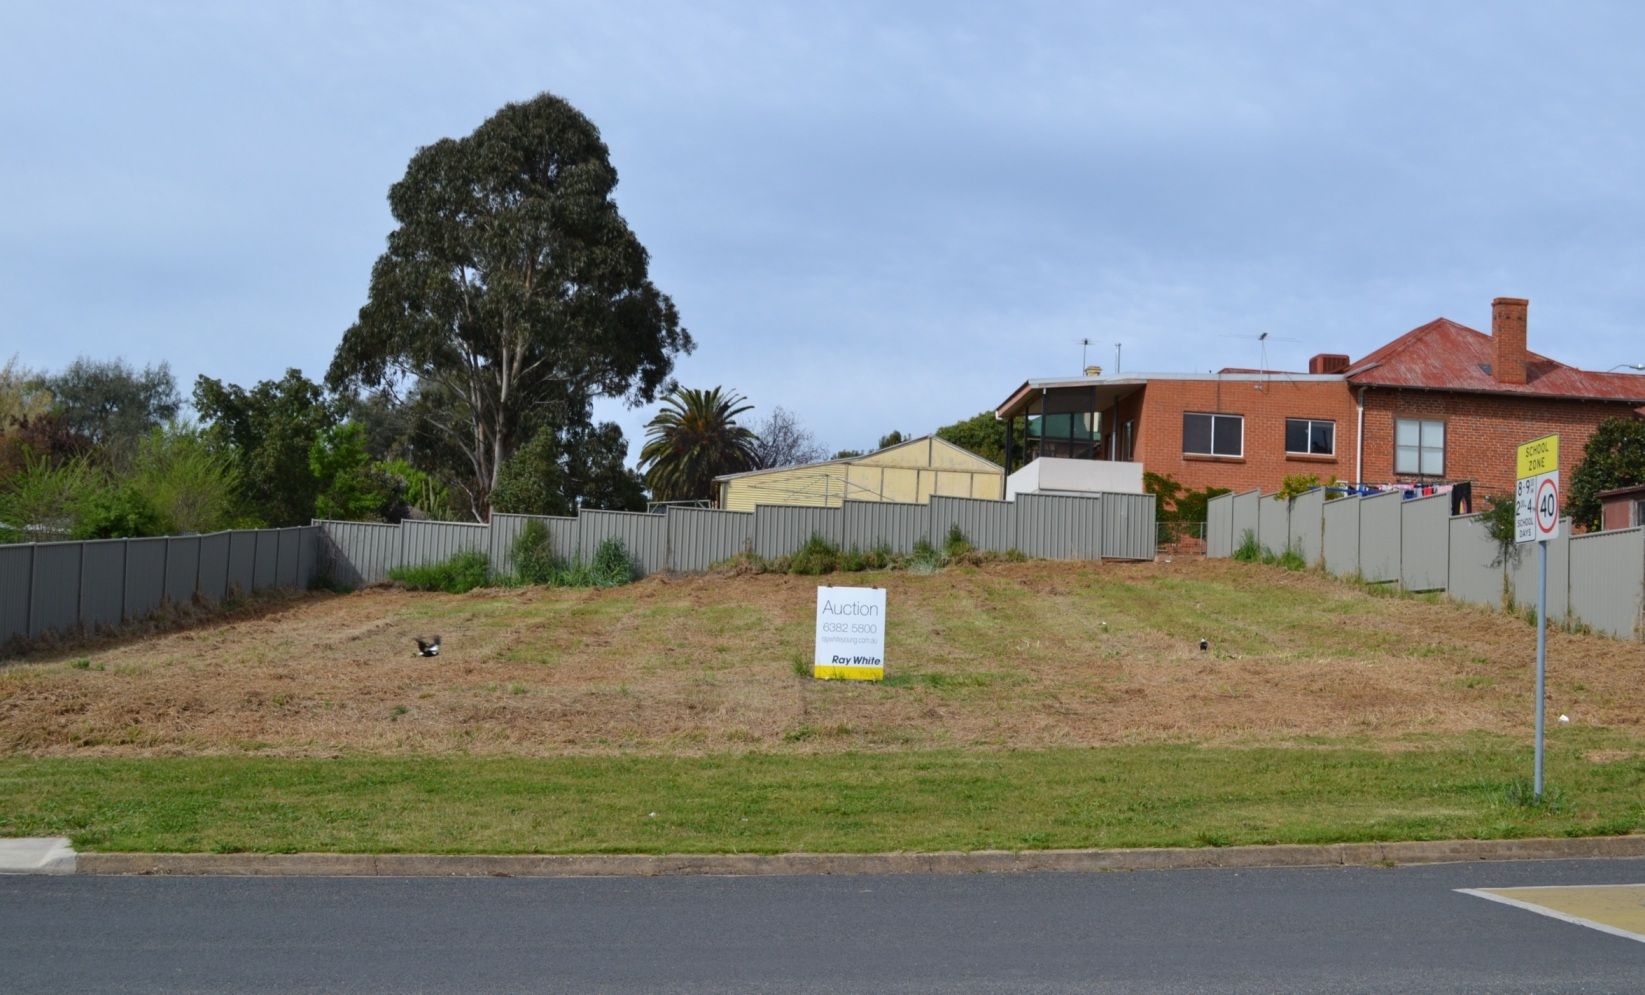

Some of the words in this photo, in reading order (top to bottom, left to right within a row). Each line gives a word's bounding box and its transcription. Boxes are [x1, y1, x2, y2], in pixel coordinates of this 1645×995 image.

[1525, 441, 1549, 458] SCHOOL
[1528, 457, 1545, 471] ZONE
[1540, 493, 1555, 518] 40
[1517, 518, 1534, 528] SCHOOL
[1519, 529, 1532, 538] DAYS
[822, 600, 879, 616] Auction
[822, 622, 848, 633] 6382
[851, 623, 878, 634] 5800
[831, 655, 852, 665] Ray
[853, 656, 881, 665] White
